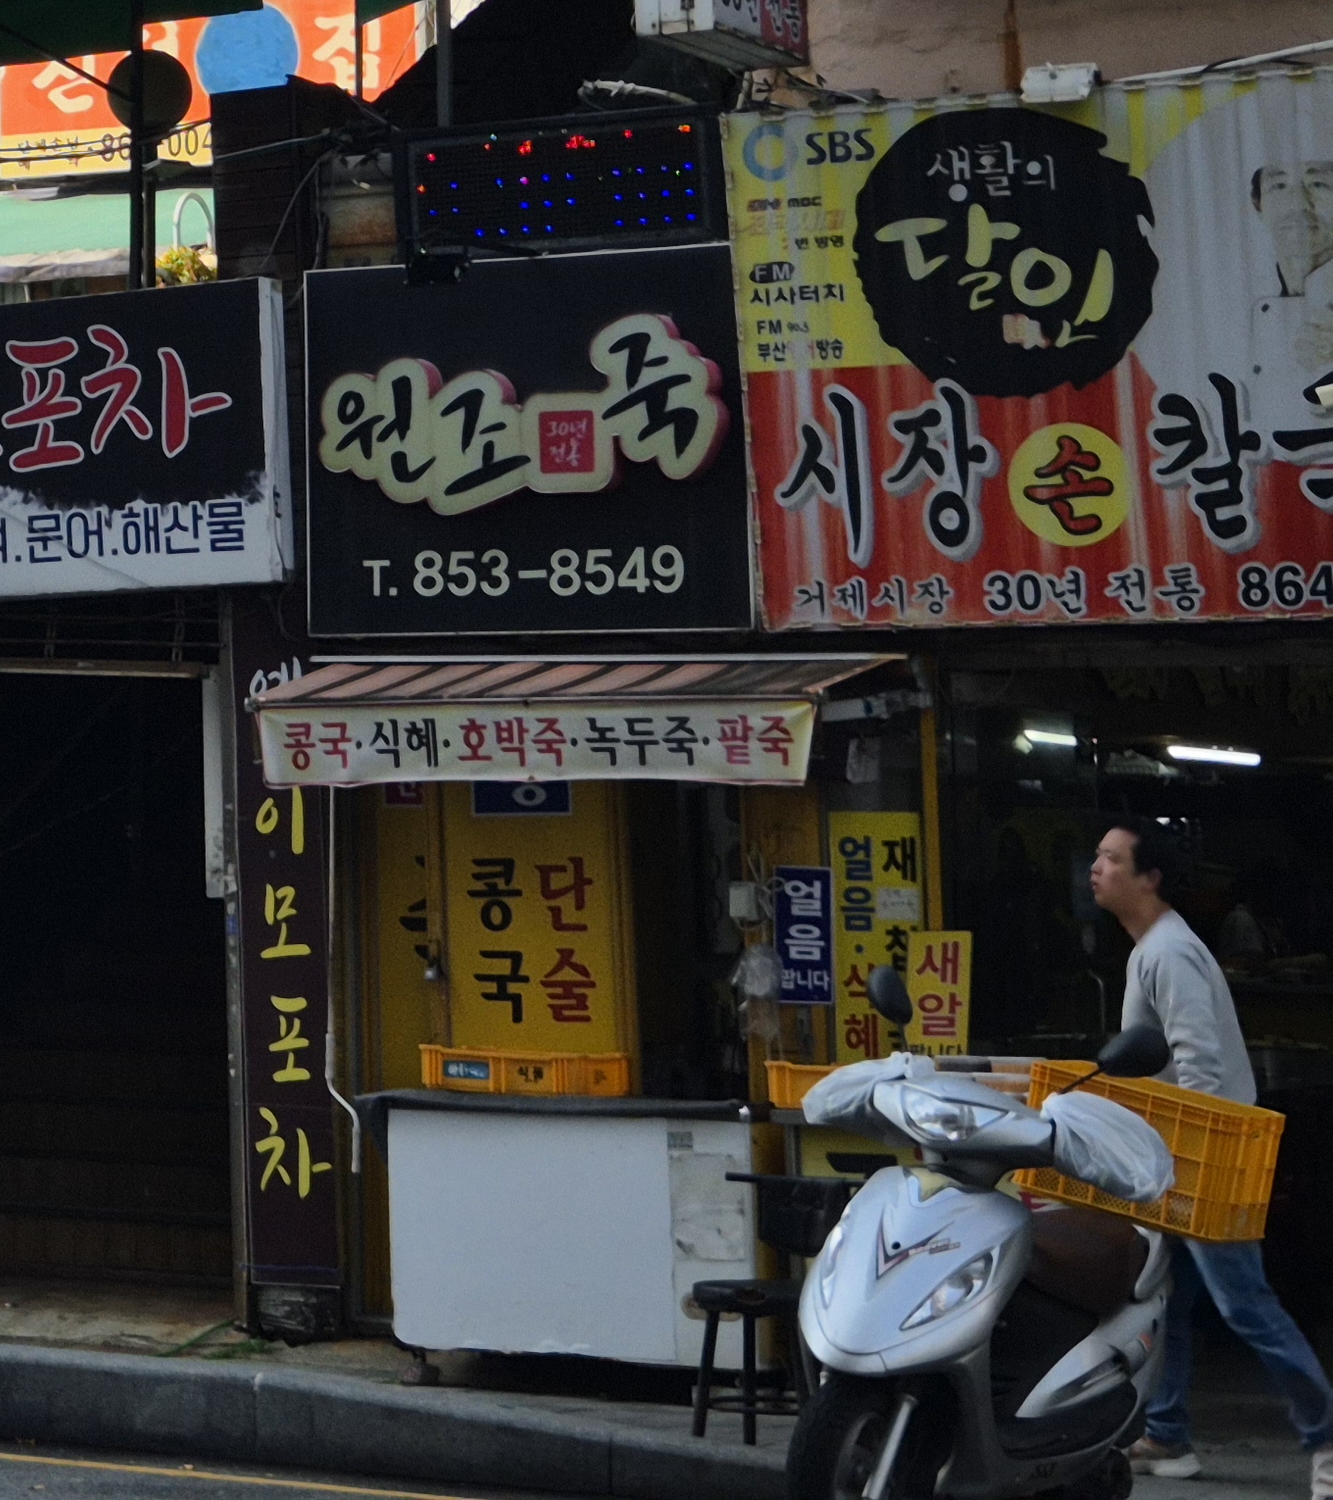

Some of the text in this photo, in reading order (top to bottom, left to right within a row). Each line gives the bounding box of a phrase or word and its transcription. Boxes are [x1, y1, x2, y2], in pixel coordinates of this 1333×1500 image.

[805, 129, 875, 165] SBS
[926, 141, 1057, 202] 생활의
[754, 264, 790, 282] FM
[874, 204, 1115, 349] 달인
[757, 320, 782, 335] FM
[335, 331, 700, 498] 원조 죽
[778, 378, 1001, 567] 시장
[1022, 434, 1115, 537] 손
[412, 545, 686, 597] 853-8549
[794, 575, 951, 617] 거제시장
[984, 567, 1087, 616] 30년
[1105, 563, 1204, 615] 전통
[282, 716, 794, 771] 콩국 식혜 호박죽 녹두죽 팥죽
[783, 879, 825, 961] 얼음
[837, 835, 876, 933] 얼음
[466, 857, 531, 1025] 콩국
[534, 856, 597, 1023] 단술
[781, 968, 831, 991] 팝니다
[255, 785, 332, 1199] 이모포차
[915, 940, 963, 1038] 새알
